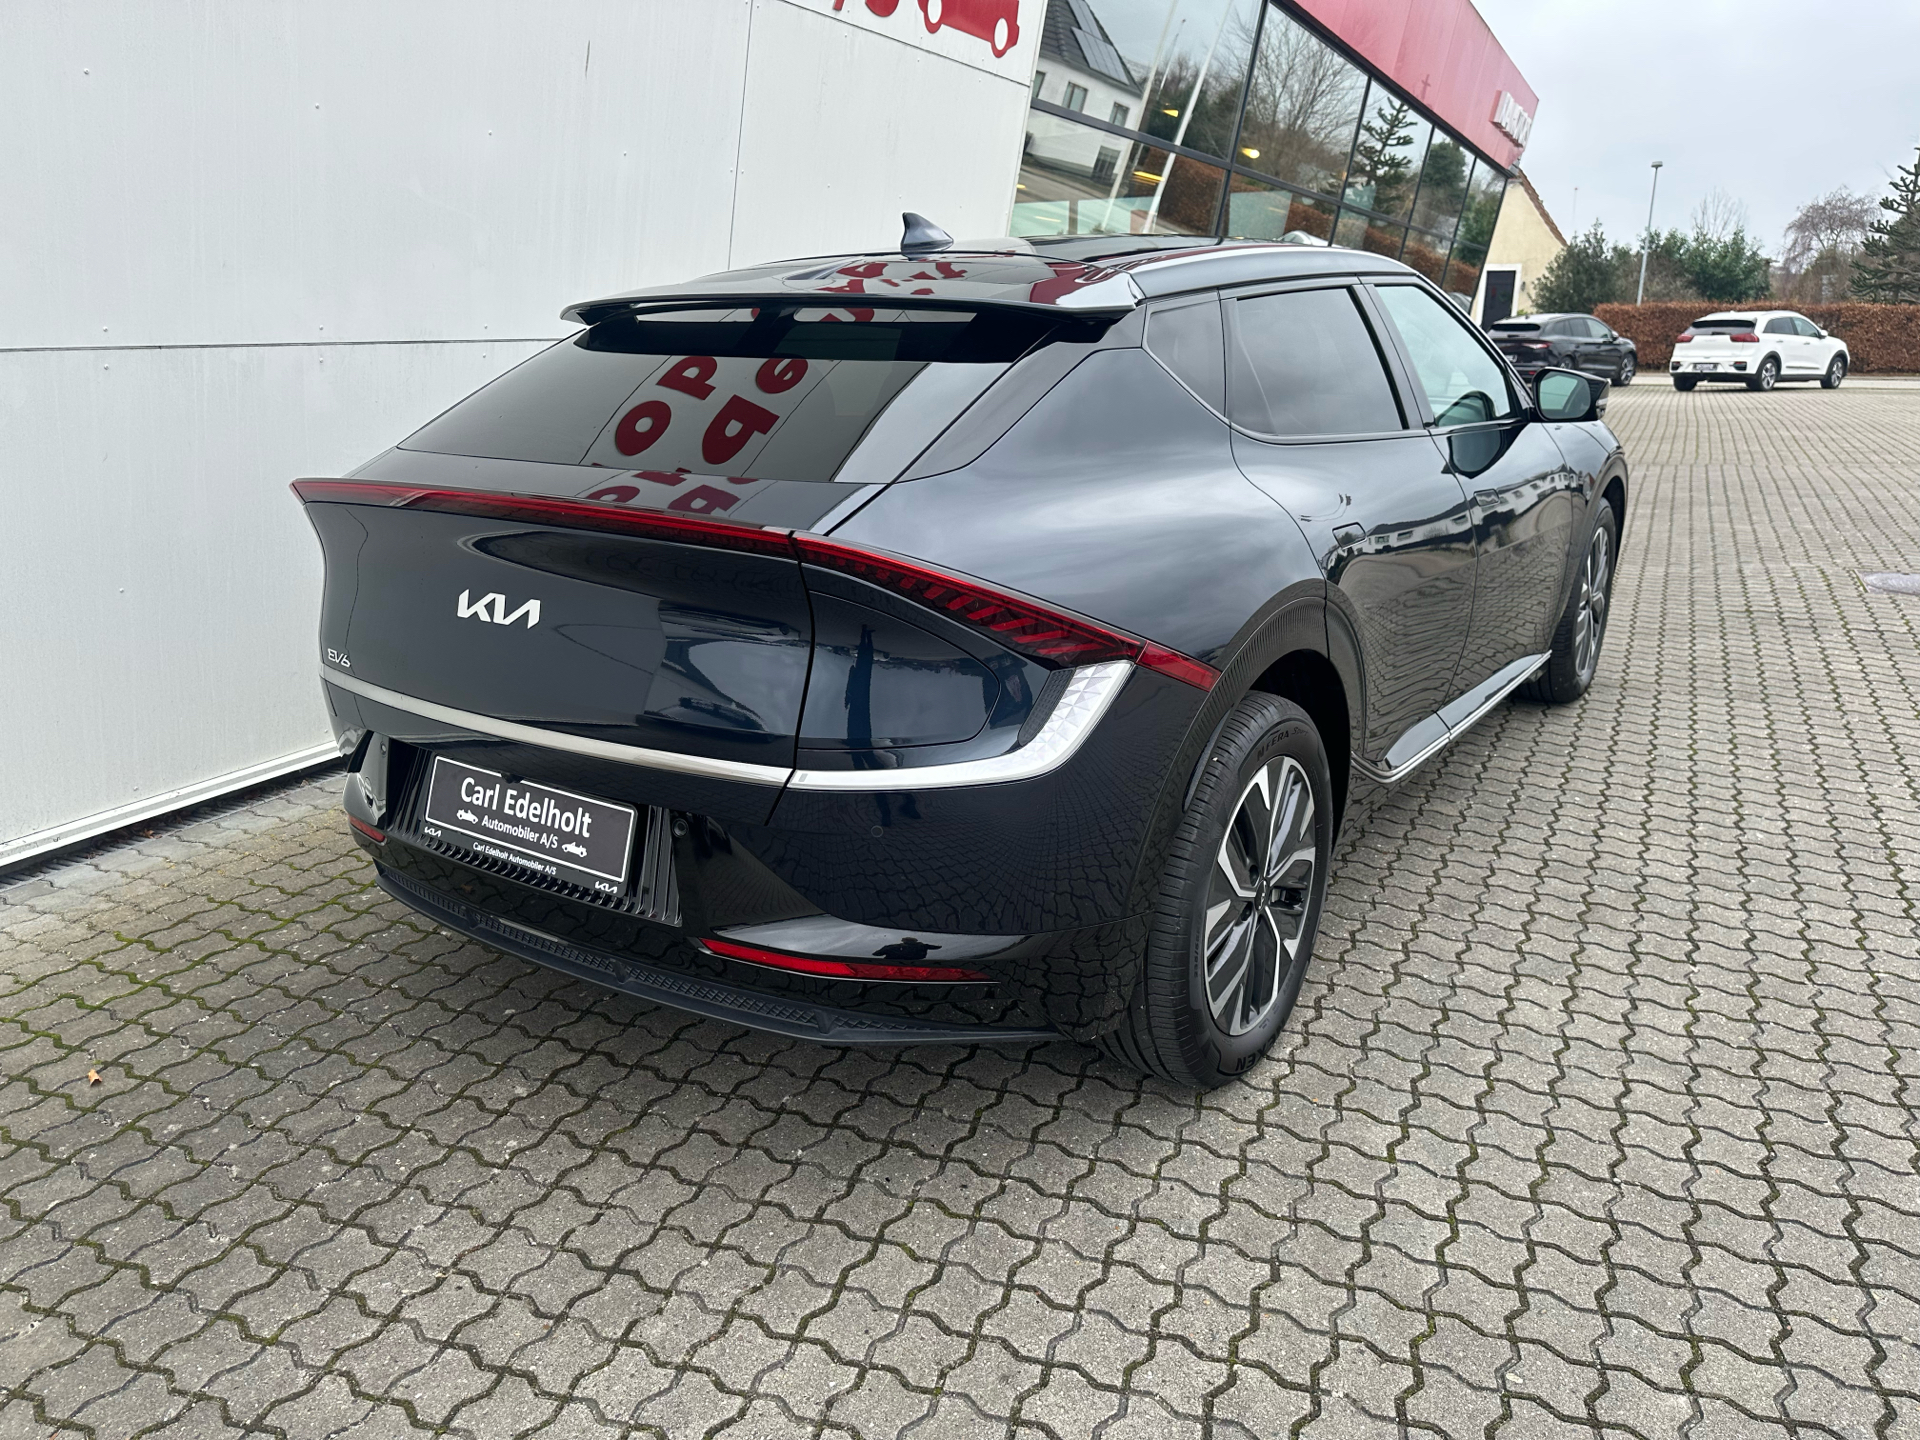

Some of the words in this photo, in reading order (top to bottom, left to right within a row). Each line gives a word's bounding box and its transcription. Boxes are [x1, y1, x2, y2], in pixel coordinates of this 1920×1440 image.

[457, 589, 541, 629] KIA
[327, 648, 351, 668] EV6
[461, 777, 500, 810] Carl
[503, 789, 592, 838] Edelholt
[481, 815, 543, 844] Automobiler
[540, 833, 559, 849] A/S
[473, 842, 485, 852] Carl
[485, 845, 509, 860] Edelholt
[508, 852, 545, 872] Automobiler
[545, 864, 557, 875] A/S
